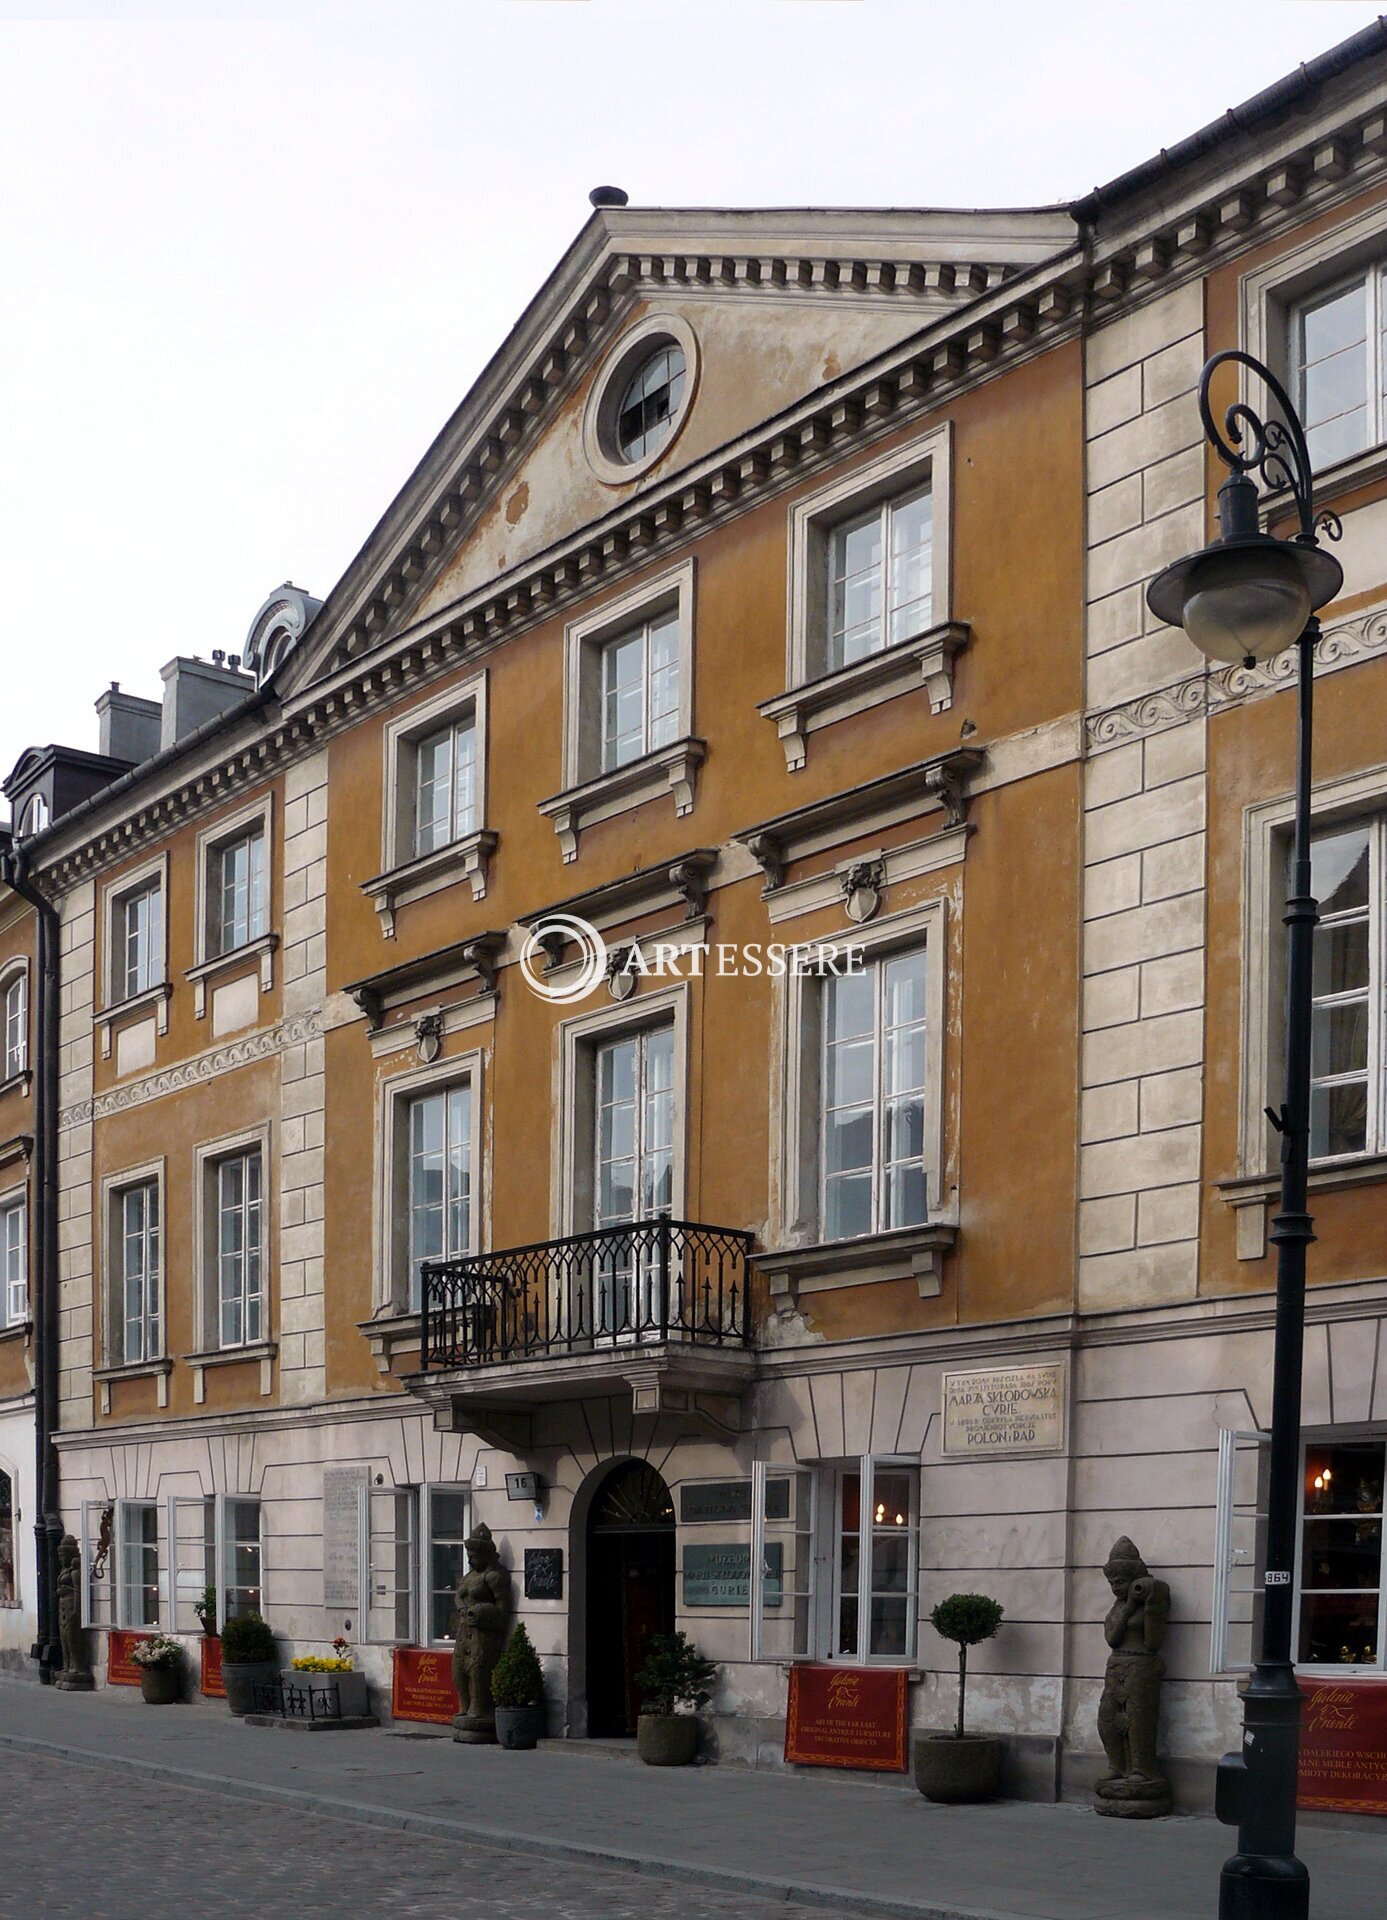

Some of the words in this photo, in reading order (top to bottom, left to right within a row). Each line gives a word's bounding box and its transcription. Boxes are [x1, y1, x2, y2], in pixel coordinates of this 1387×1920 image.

[986, 1387, 1057, 1403] SKŁODOWSKA
[967, 1431, 1007, 1445] POLON
[1013, 1429, 1035, 1443] RAD
[514, 1477, 527, 1489] 16
[711, 1585, 749, 1596] CURIE
[1303, 1749, 1355, 1758] DALEKIEGO
[1322, 1760, 1352, 1769] MEBLE
